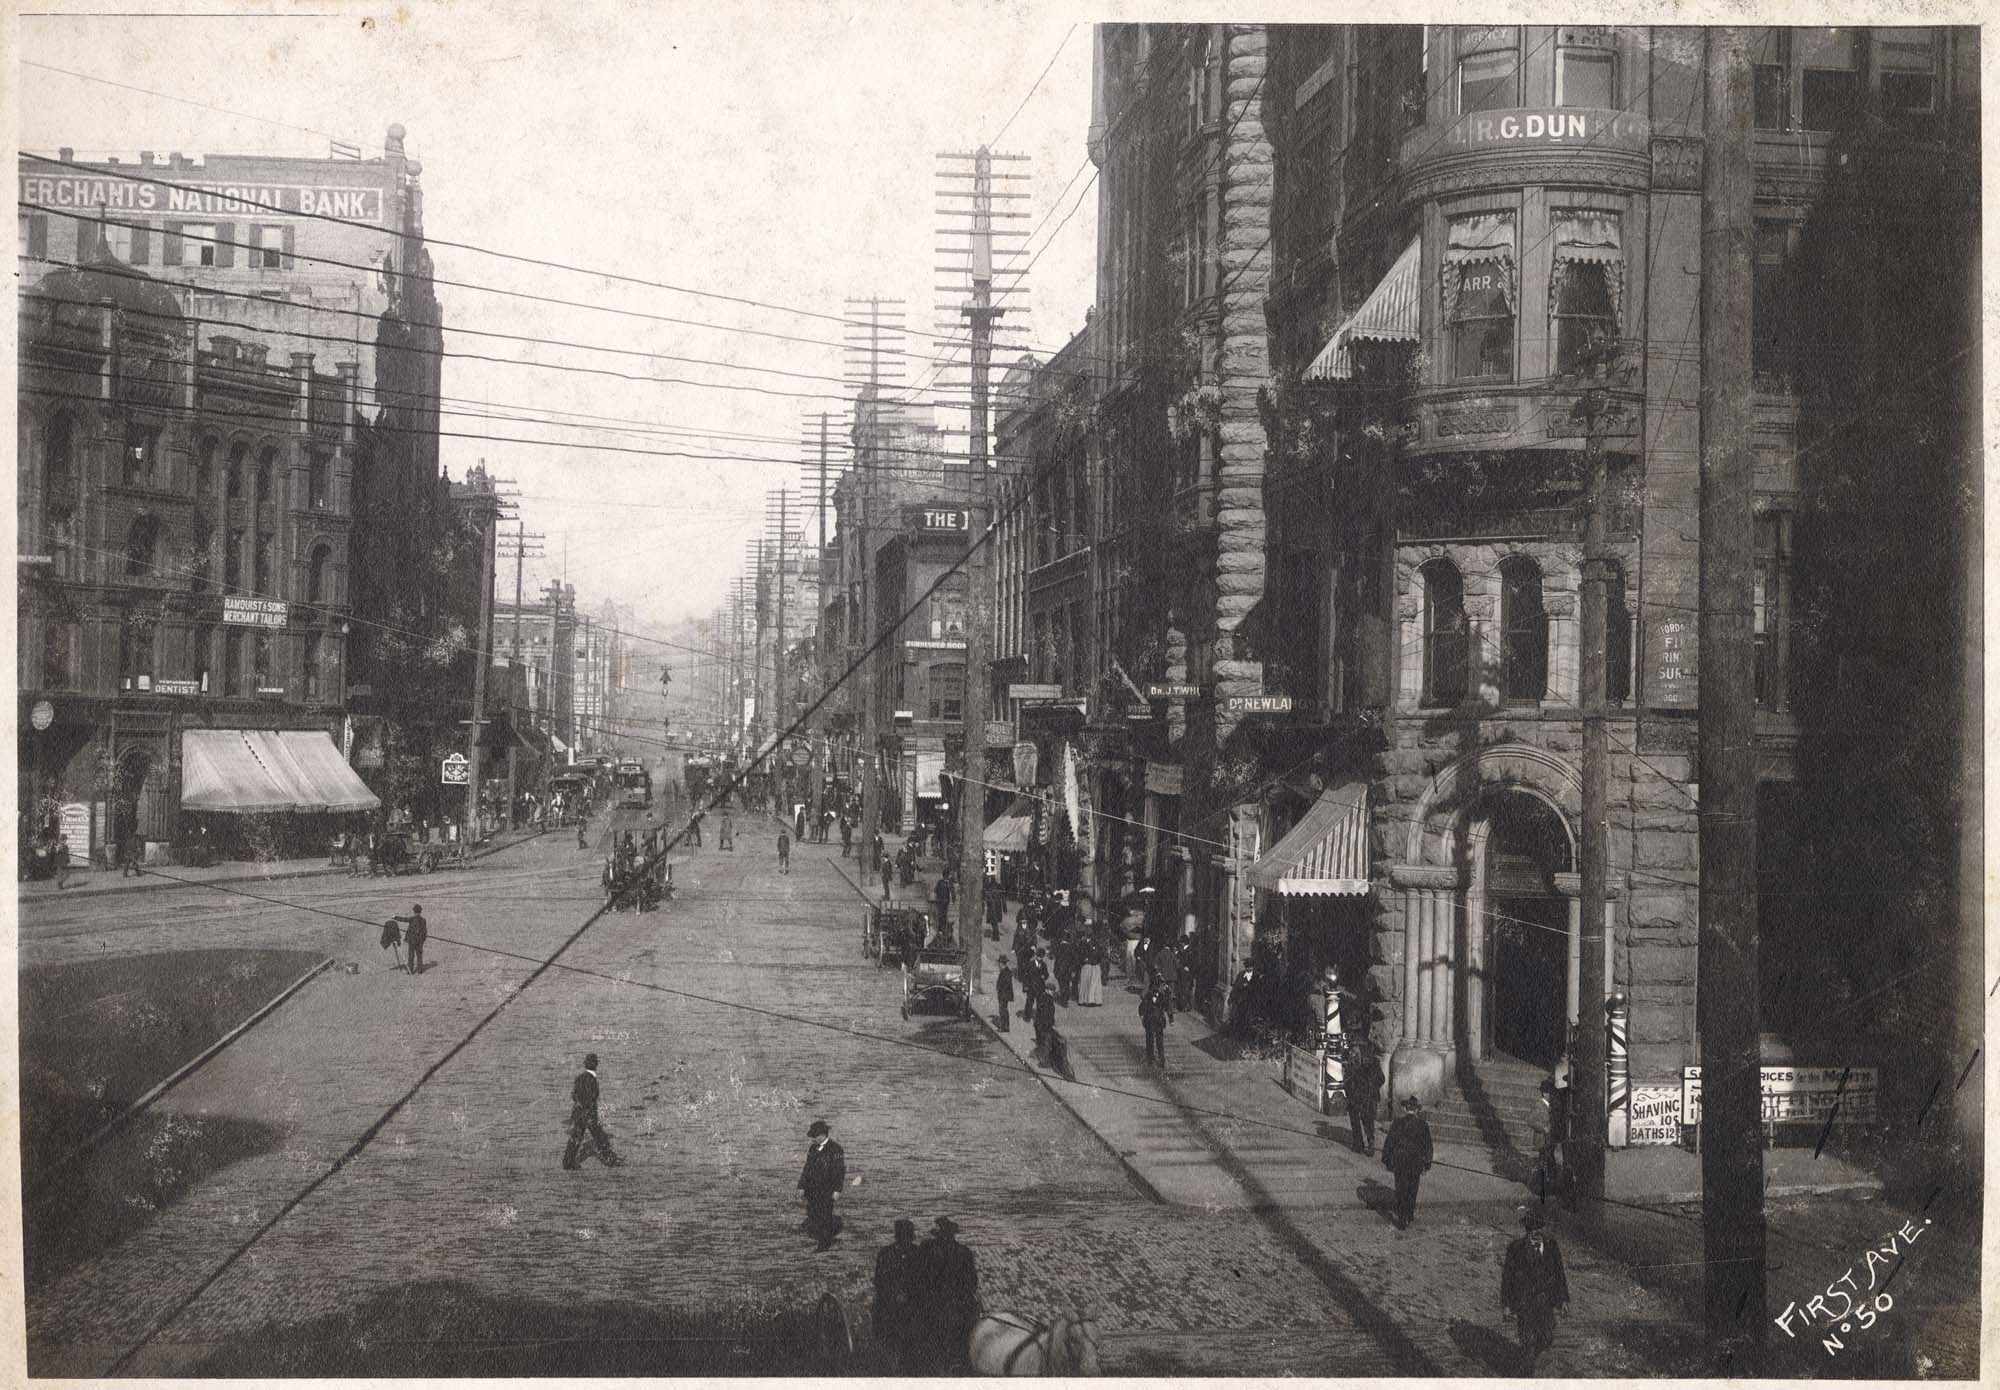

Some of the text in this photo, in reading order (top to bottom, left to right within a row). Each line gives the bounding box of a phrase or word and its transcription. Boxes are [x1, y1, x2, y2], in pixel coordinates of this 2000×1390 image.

[18, 179, 156, 208] ERCHANTS
[169, 185, 281, 213] NATIONAL
[1463, 276, 1491, 291] ARR
[924, 512, 957, 528] THE
[224, 610, 287, 626] MERCHANT TAILORS
[1632, 1099, 1680, 1120] SHAVING
[1631, 1126, 1664, 1140] BATHS
